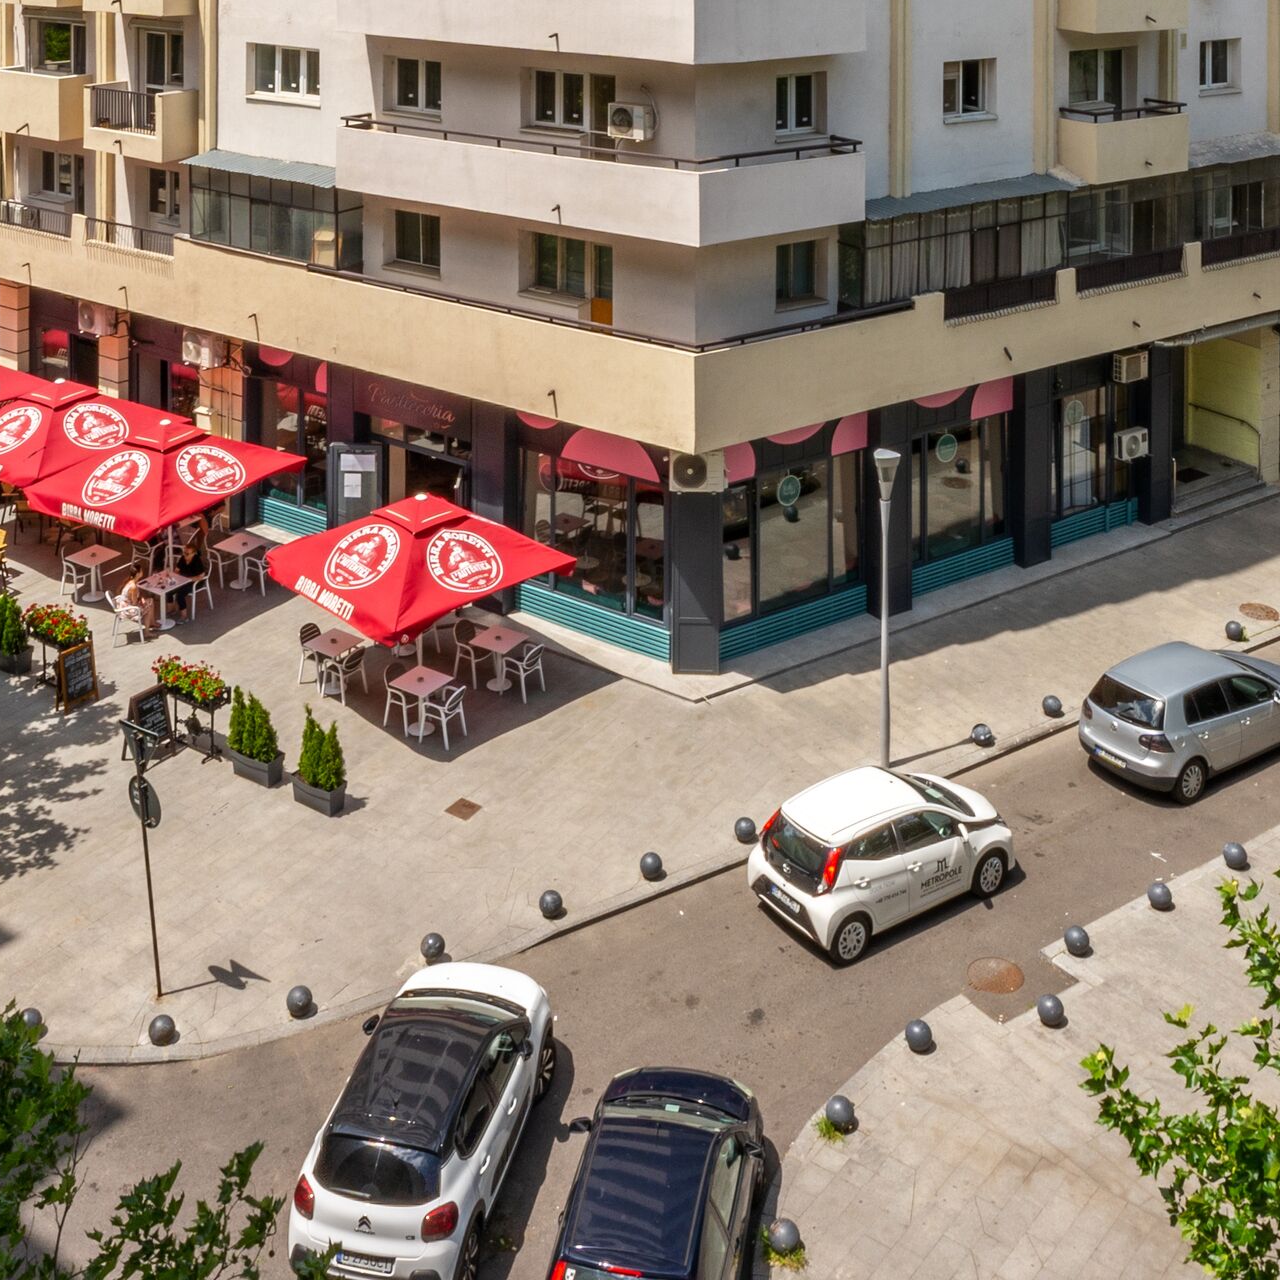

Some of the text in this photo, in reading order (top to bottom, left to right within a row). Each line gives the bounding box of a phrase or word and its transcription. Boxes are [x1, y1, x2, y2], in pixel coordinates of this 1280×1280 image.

[77, 405, 122, 422] MORETTI
[179, 447, 236, 482] BIRRA MORETTI
[62, 502, 116, 530] BIRRA MORETTI
[339, 526, 397, 572] BIRRA MORETTI
[429, 532, 494, 576] BIRRA MORETTI
[294, 575, 355, 621] BIRRA MORETTI
[921, 865, 963, 889] METROPOLE
